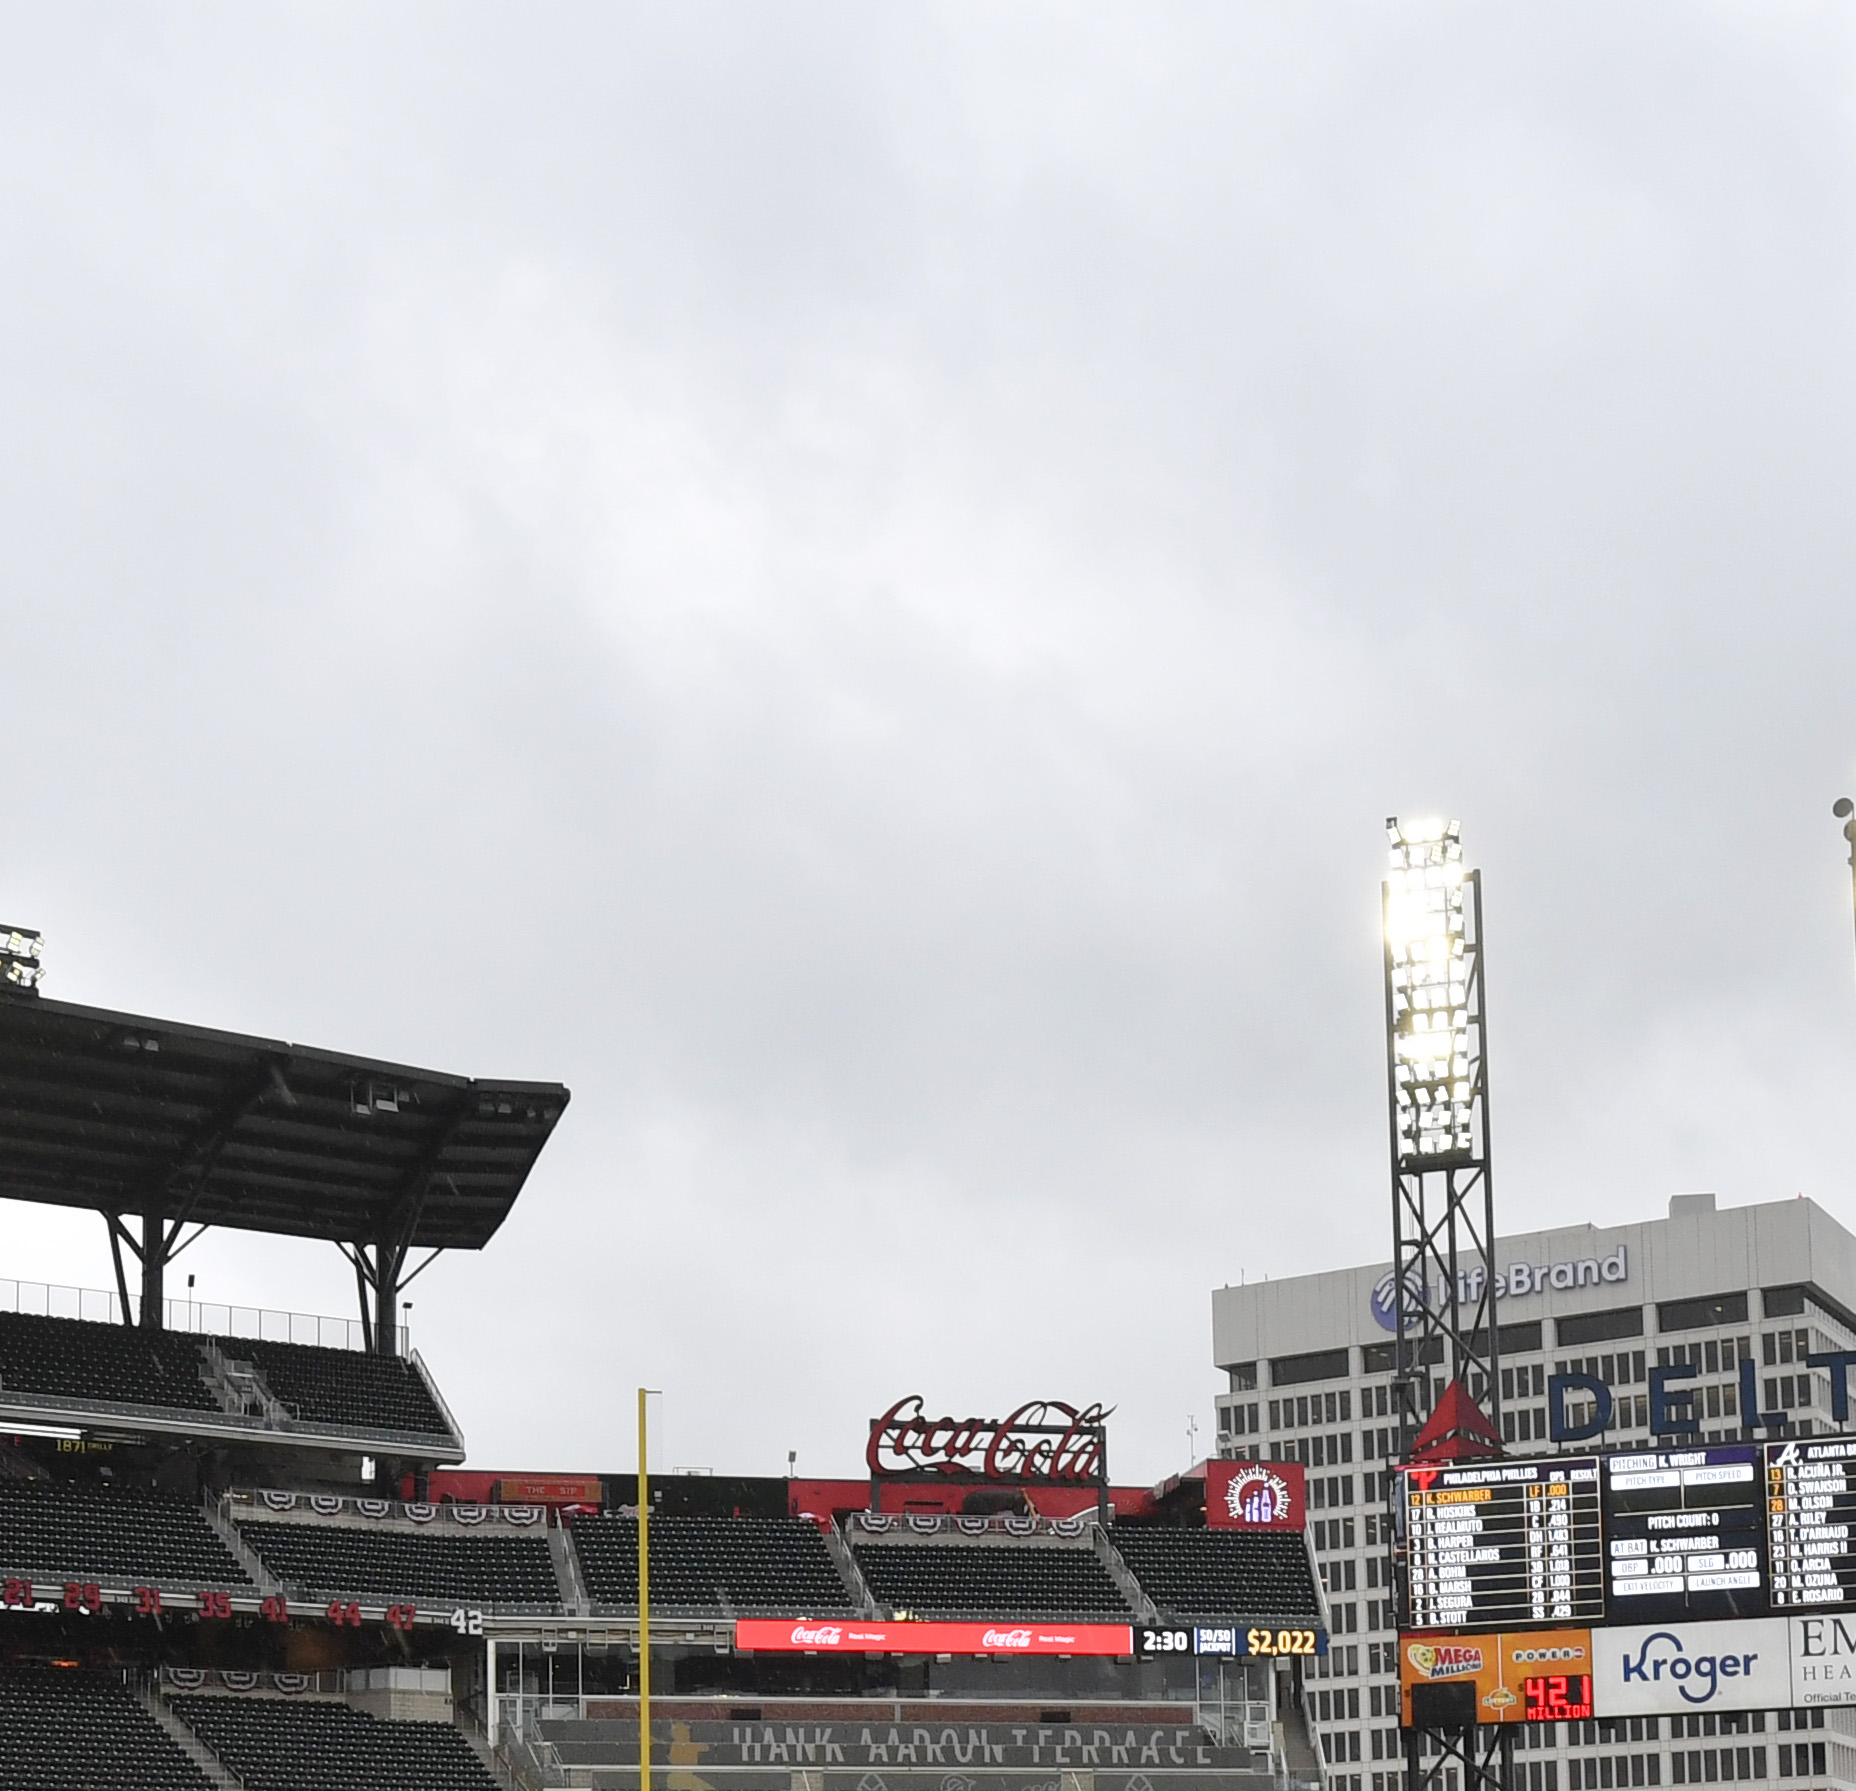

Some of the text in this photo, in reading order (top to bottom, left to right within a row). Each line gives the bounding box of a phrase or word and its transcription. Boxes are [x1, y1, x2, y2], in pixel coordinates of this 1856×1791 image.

[56, 1438, 86, 1454] 1871
[1807, 1445, 1846, 1459] ATLANTA
[1443, 1467, 1538, 1485] PHILADELPHIA PHILLIES
[1648, 1515, 1675, 1530] PITCH
[1677, 1514, 1710, 1528] COUNT:
[4, 1577, 33, 1606] 21
[64, 1582, 101, 1610] 29
[134, 1586, 162, 1614] 31
[198, 1591, 232, 1618] 35
[261, 1596, 289, 1623] 41
[326, 1600, 362, 1627] 44
[386, 1604, 417, 1630] 47
[450, 1608, 484, 1635] 42
[1143, 1631, 1188, 1651] 2:30
[1199, 1629, 1231, 1643] 50/50
[1199, 1642, 1231, 1653] JACKPOT
[1247, 1627, 1316, 1656] $2,022
[1434, 1646, 1481, 1665] MEGA
[1622, 1632, 1758, 1703] Kroger
[1430, 1660, 1482, 1678] MILLIONS
[1526, 1676, 1591, 1706] 421
[1804, 1692, 1842, 1704] Official
[1527, 1705, 1591, 1721] MILLION
[732, 1727, 1212, 1764] HANK AARON TERRACE
